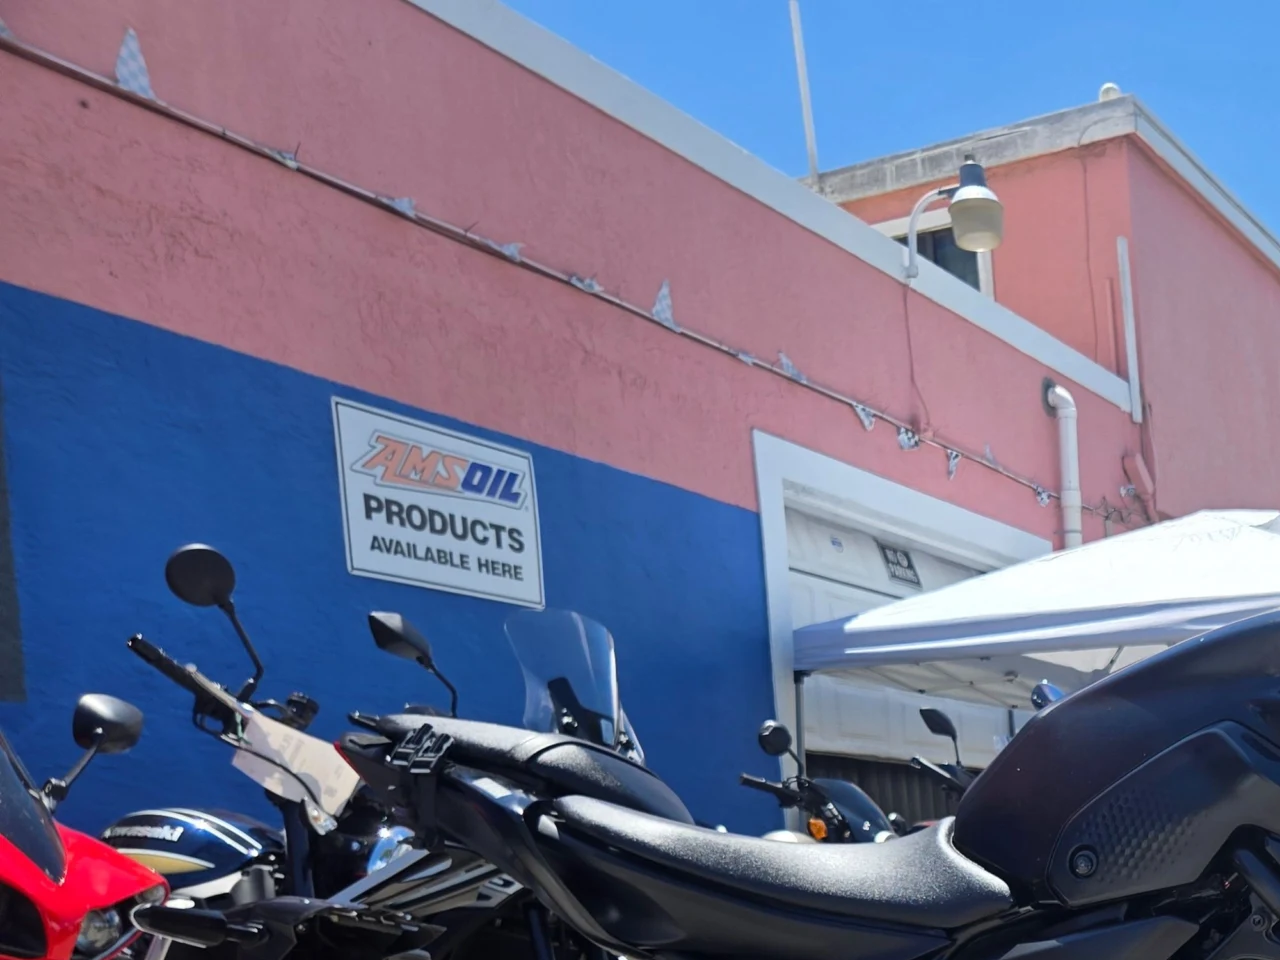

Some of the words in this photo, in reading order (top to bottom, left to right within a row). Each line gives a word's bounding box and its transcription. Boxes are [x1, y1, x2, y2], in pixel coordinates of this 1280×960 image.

[363, 435, 521, 503] AMSOIL
[363, 493, 525, 553] PRODUCTS
[370, 535, 471, 571] AVAILABLE
[477, 556, 524, 581] HERE
